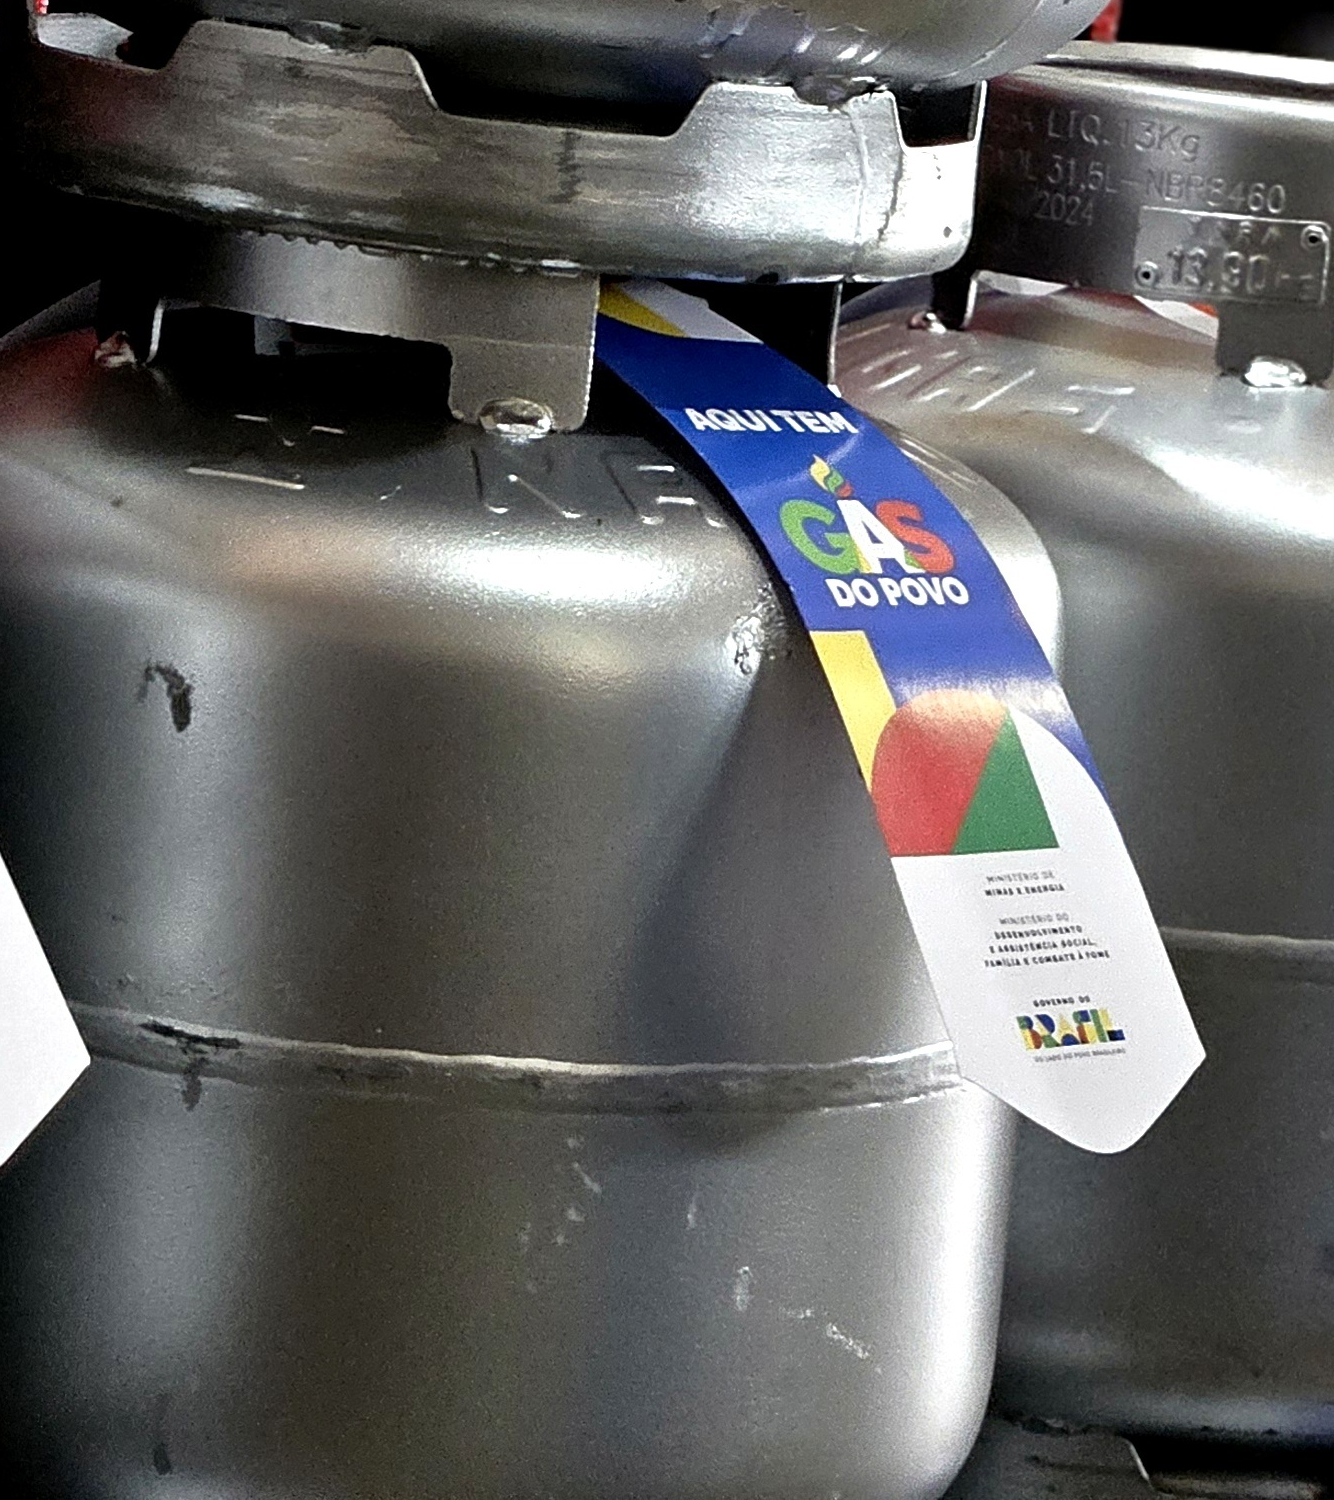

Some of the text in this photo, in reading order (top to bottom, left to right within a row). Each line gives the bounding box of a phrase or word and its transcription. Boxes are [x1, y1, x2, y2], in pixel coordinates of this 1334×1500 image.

[685, 408, 859, 433] AQUI TEM
[825, 577, 969, 607] DO POVO
[1016, 1007, 1126, 1051] BRASIL
